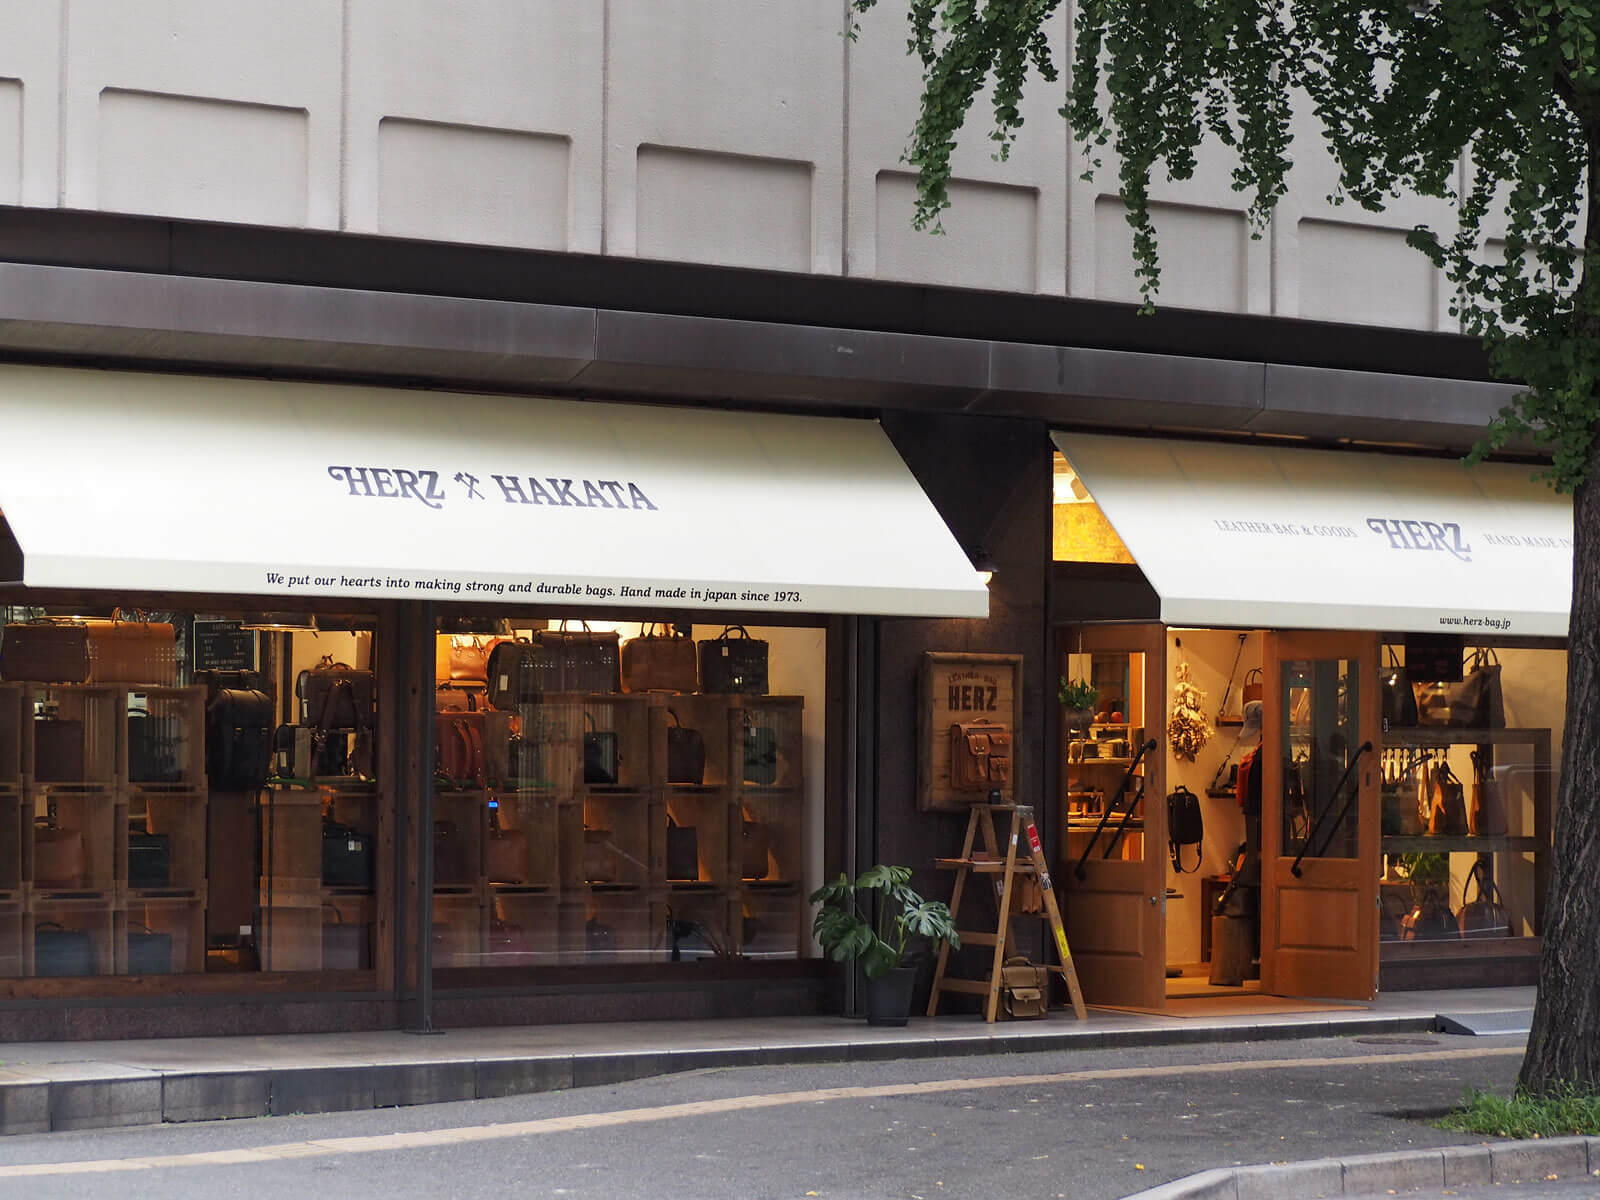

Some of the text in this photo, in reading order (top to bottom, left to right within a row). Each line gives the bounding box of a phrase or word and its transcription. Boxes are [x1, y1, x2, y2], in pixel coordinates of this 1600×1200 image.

[328, 465, 659, 512] HERZ HAKATA
[1214, 519, 1359, 539] LEATHER BAG & GOODS
[1366, 518, 1473, 562] HERZ
[1484, 533, 1520, 546] HAND
[1521, 535, 1559, 548] MADE
[266, 572, 803, 603] We put our hearts into making strong and durable bags. Hand made in japan since 1973.
[1439, 614, 1511, 630] www.herz-bag.jp
[949, 685, 998, 711] HERZ
